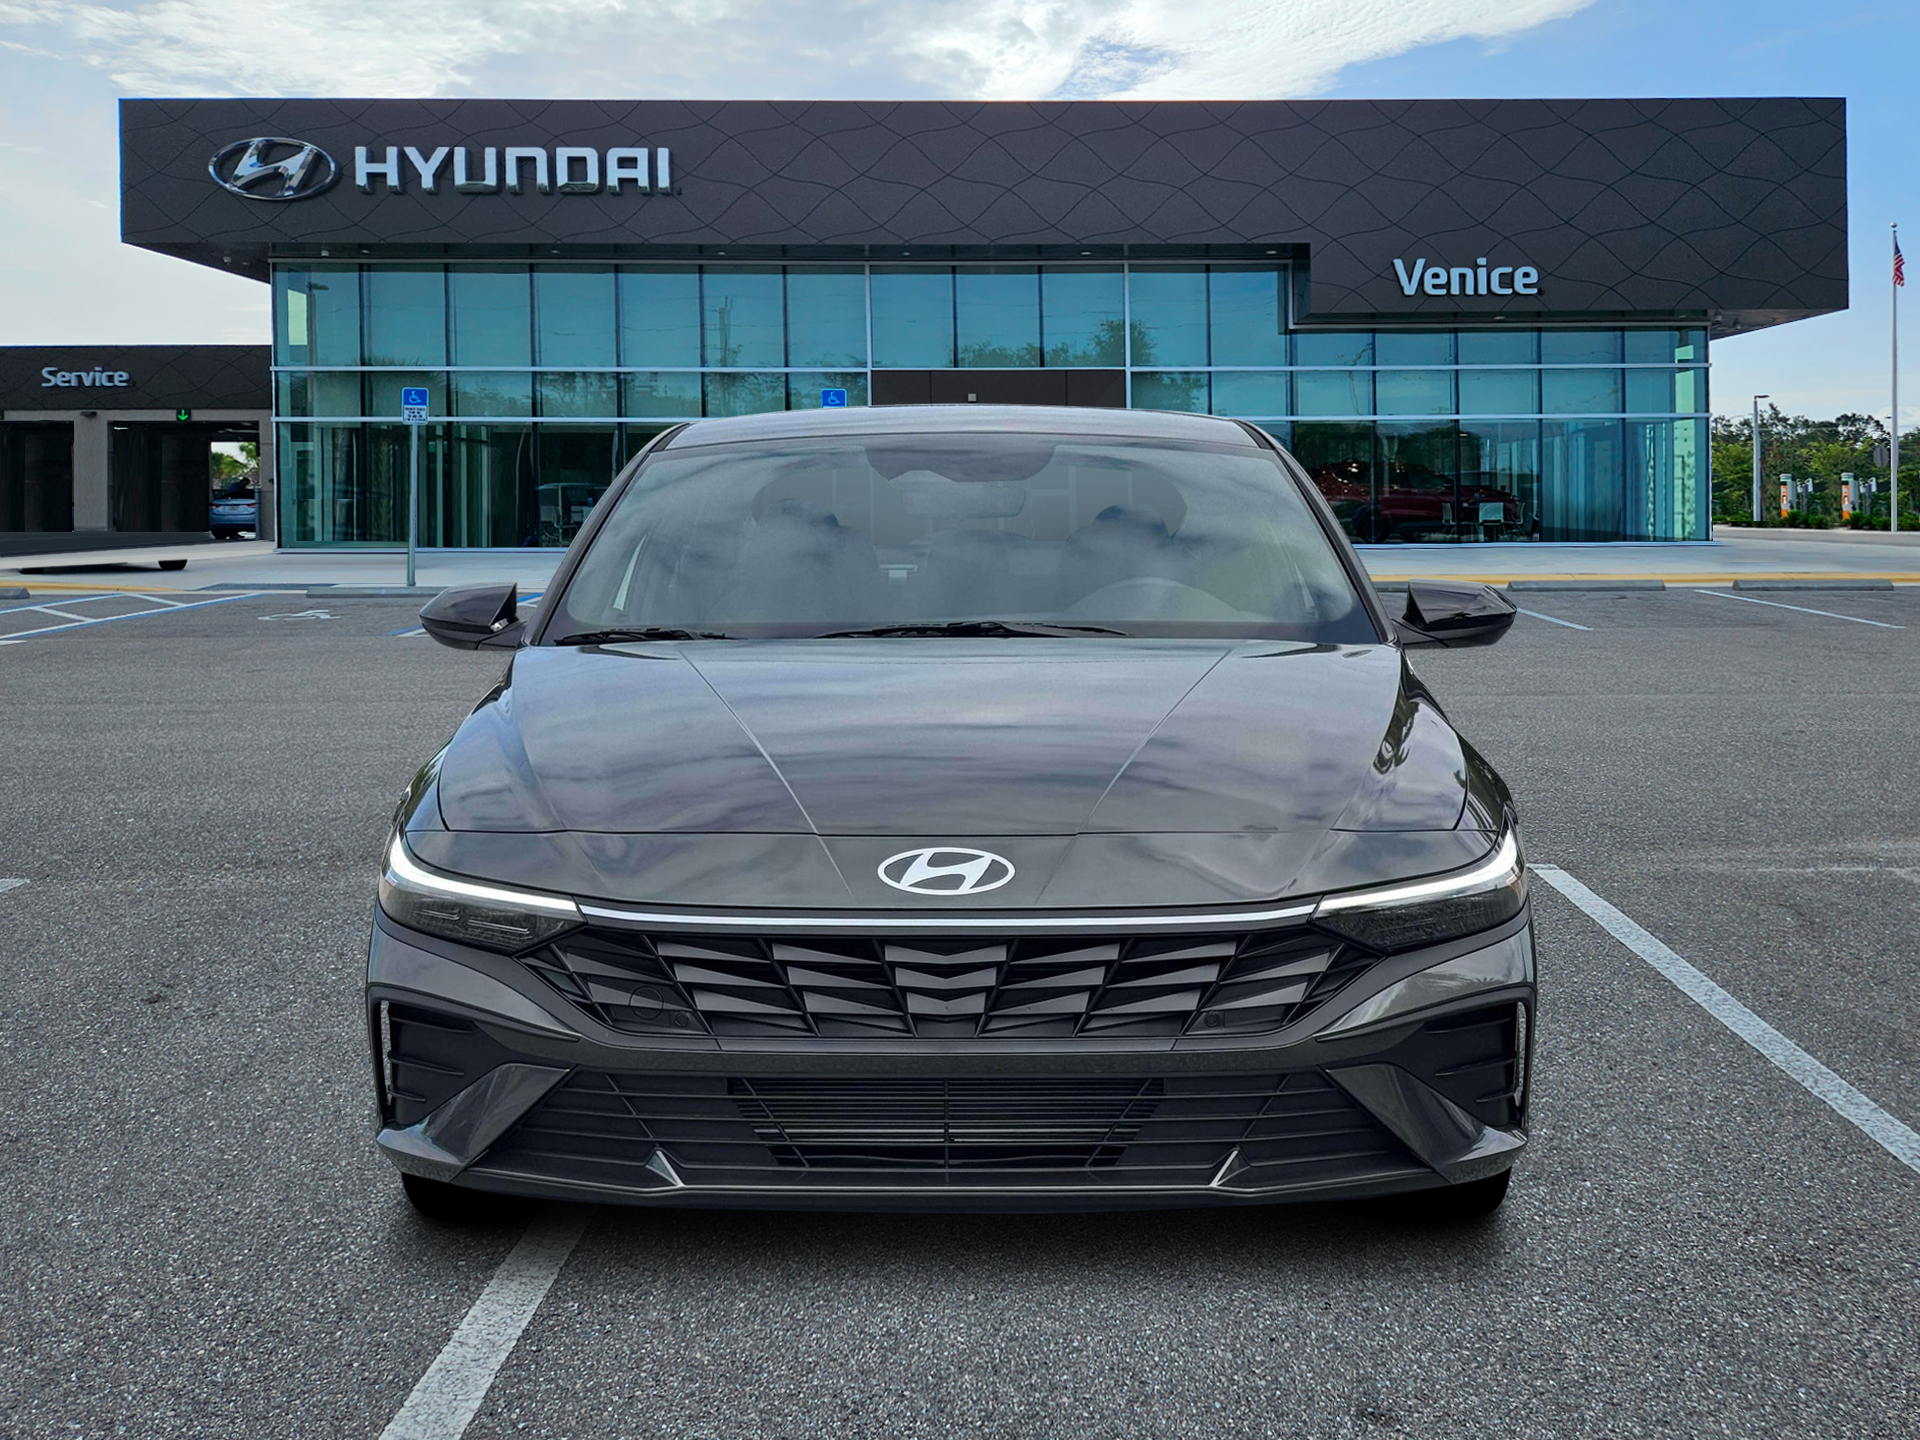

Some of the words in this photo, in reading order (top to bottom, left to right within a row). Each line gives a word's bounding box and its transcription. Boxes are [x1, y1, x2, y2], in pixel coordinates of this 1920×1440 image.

[354, 146, 671, 194] HYUNDAI
[1393, 257, 1539, 296] Venice
[41, 366, 130, 387] Service
